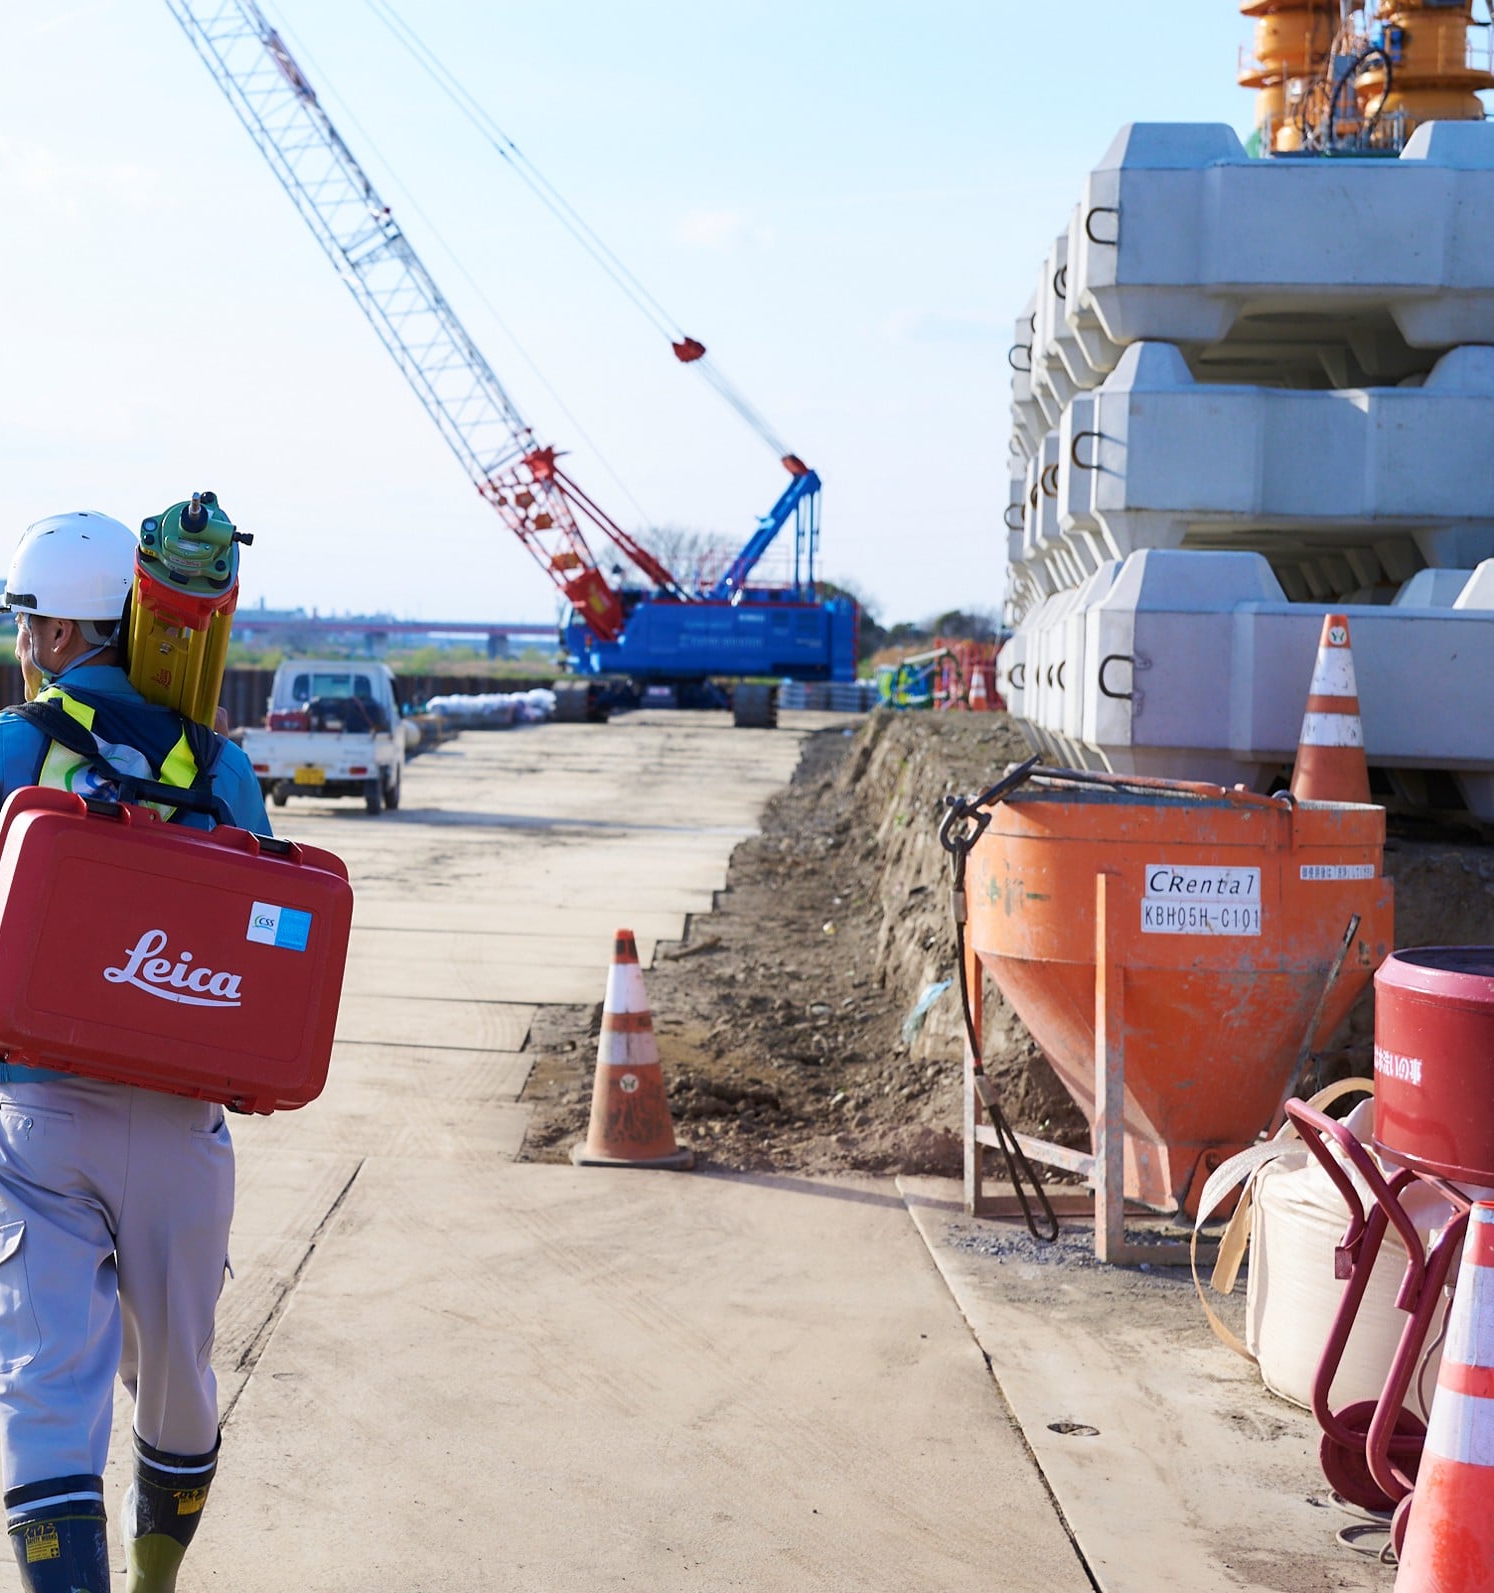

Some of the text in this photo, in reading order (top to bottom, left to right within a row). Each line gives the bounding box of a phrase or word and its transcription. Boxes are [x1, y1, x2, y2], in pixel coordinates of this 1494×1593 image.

[1149, 870, 1255, 895] CRental
[258, 917, 275, 928] CSS
[1144, 905, 1260, 930] KBH05H-C101
[103, 929, 243, 1007] Leica
